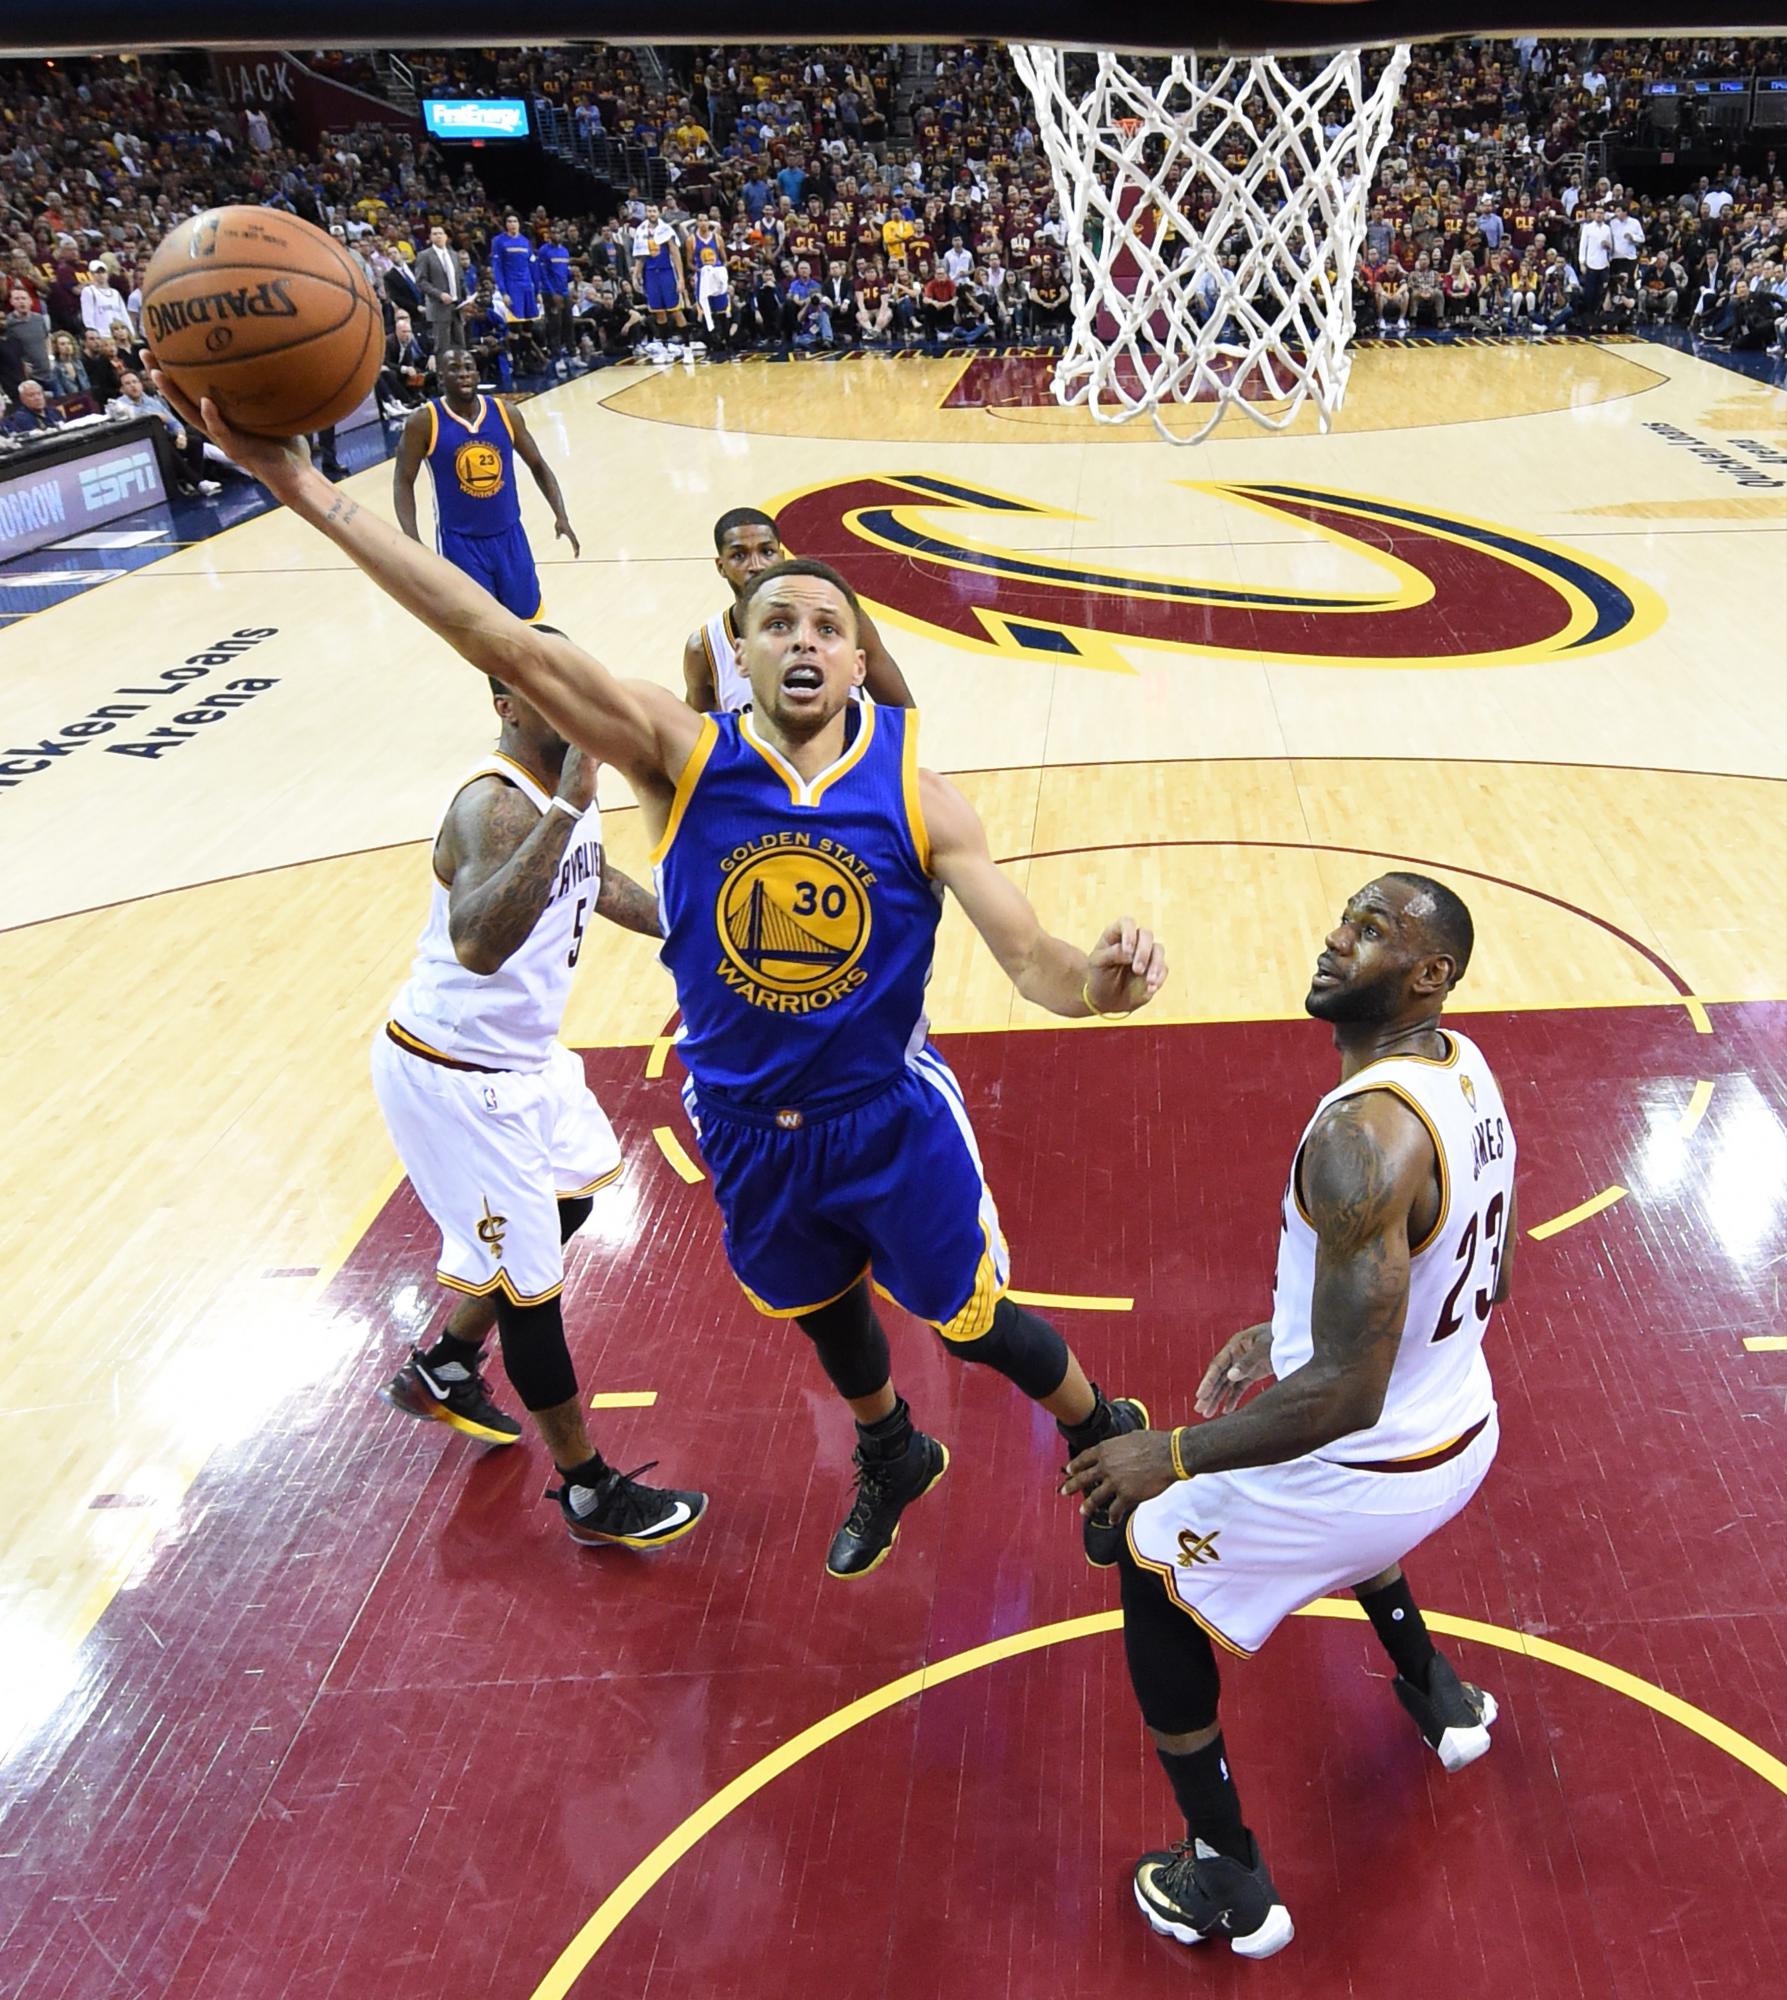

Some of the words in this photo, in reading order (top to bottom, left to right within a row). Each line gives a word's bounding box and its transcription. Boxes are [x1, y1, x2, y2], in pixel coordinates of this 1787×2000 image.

[827, 229, 847, 247] CLE
[1444, 218, 1463, 232] CLE
[1515, 215, 1536, 231] CLE
[147, 279, 298, 343] SPALDING
[479, 454, 495, 466] 23
[0, 480, 66, 542] ORROW
[79, 452, 157, 511] ESPN
[113, 627, 279, 694] Loans
[103, 678, 282, 760] Arena
[546, 841, 604, 908] AVALIE
[720, 831, 811, 872] GOLDEN
[819, 838, 878, 888] STATE
[793, 881, 846, 919] 30
[567, 898, 587, 968] 5
[716, 958, 869, 1014] WARRIORS
[1430, 1191, 1504, 1344] 23
